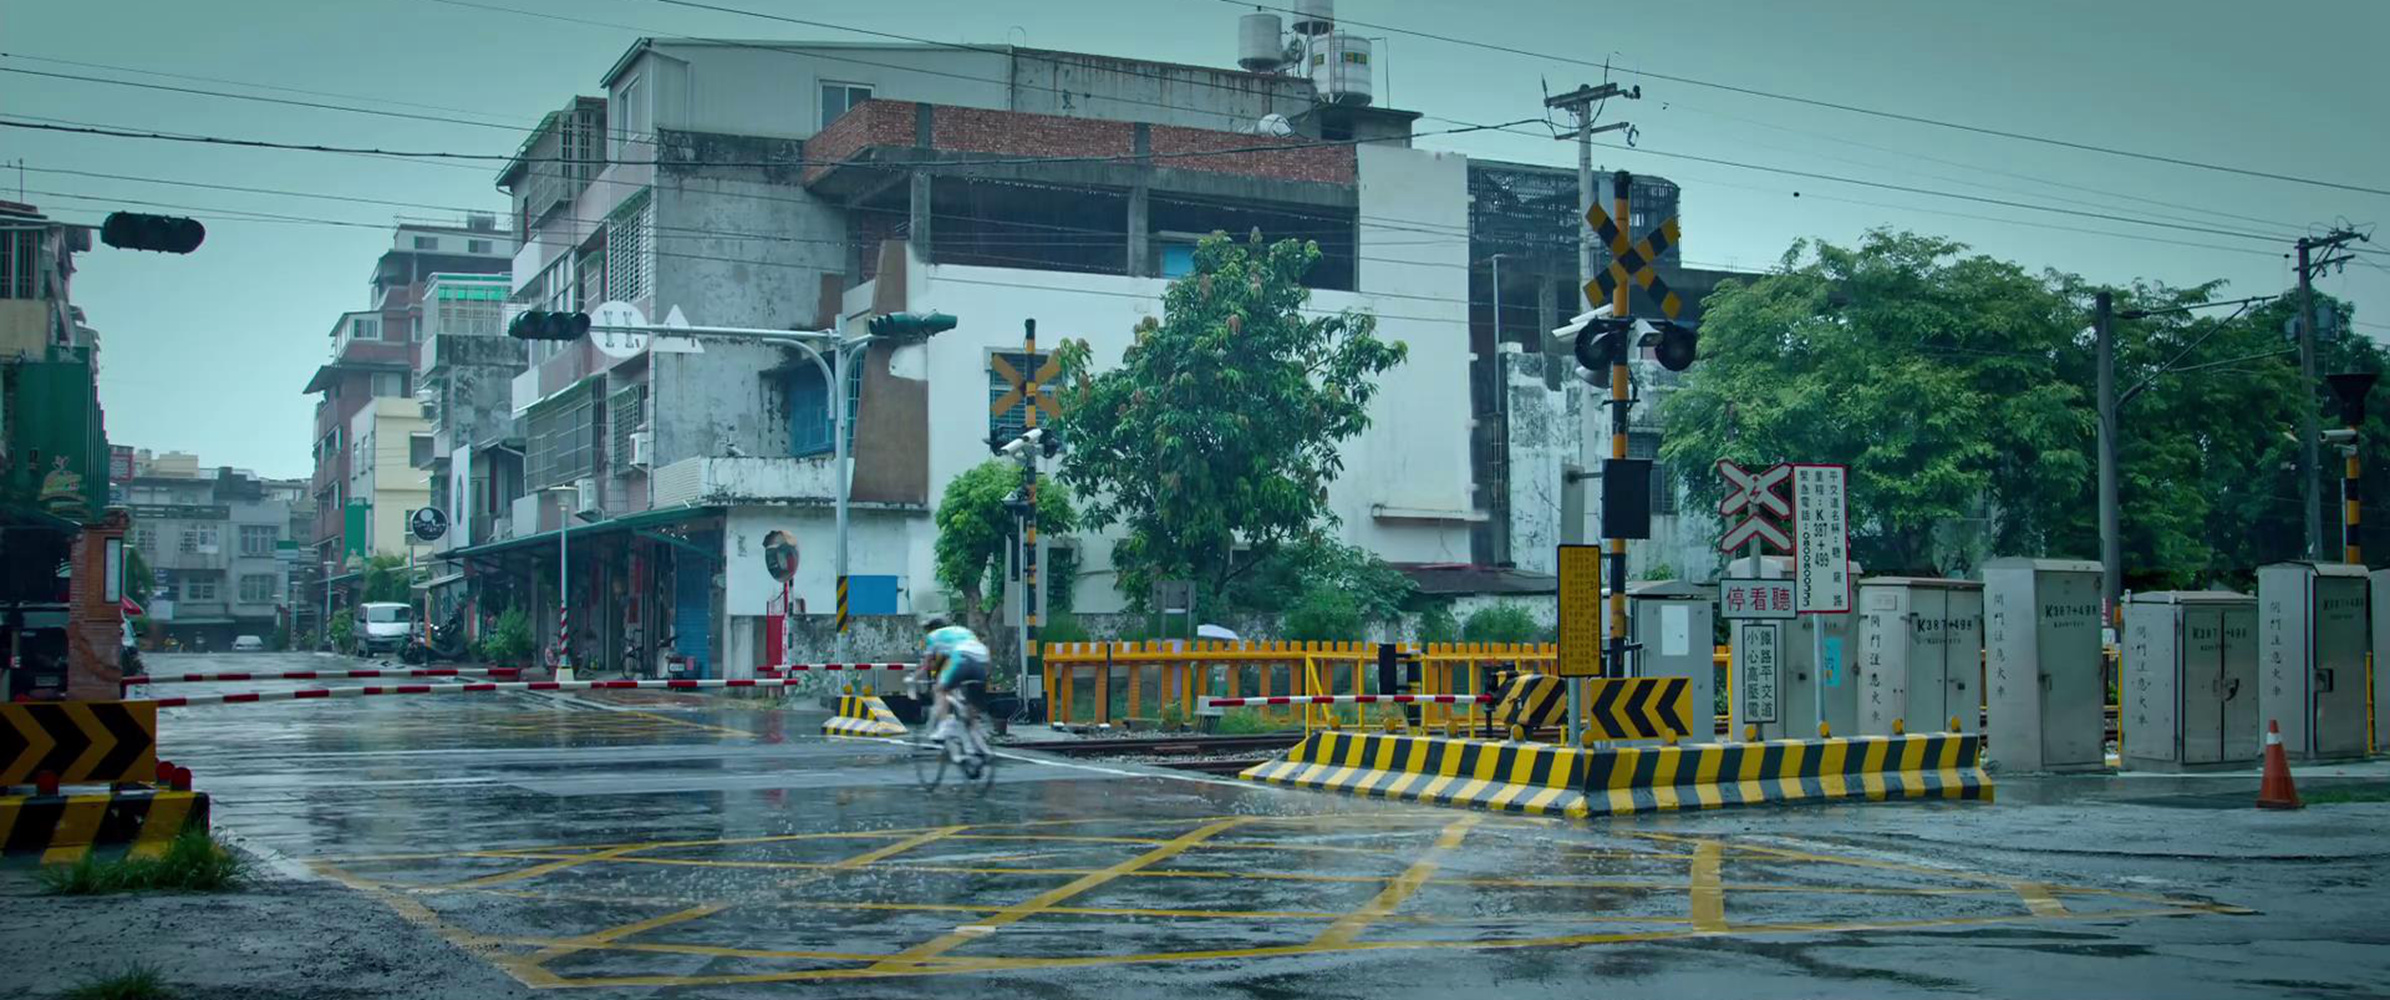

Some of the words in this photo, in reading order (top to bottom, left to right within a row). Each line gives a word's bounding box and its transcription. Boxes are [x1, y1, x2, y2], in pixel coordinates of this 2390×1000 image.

[1726, 586, 1792, 612] 停看聽
[1746, 629, 1760, 718] 小心高壓電
[1760, 629, 1774, 718] 鐵路平交道
